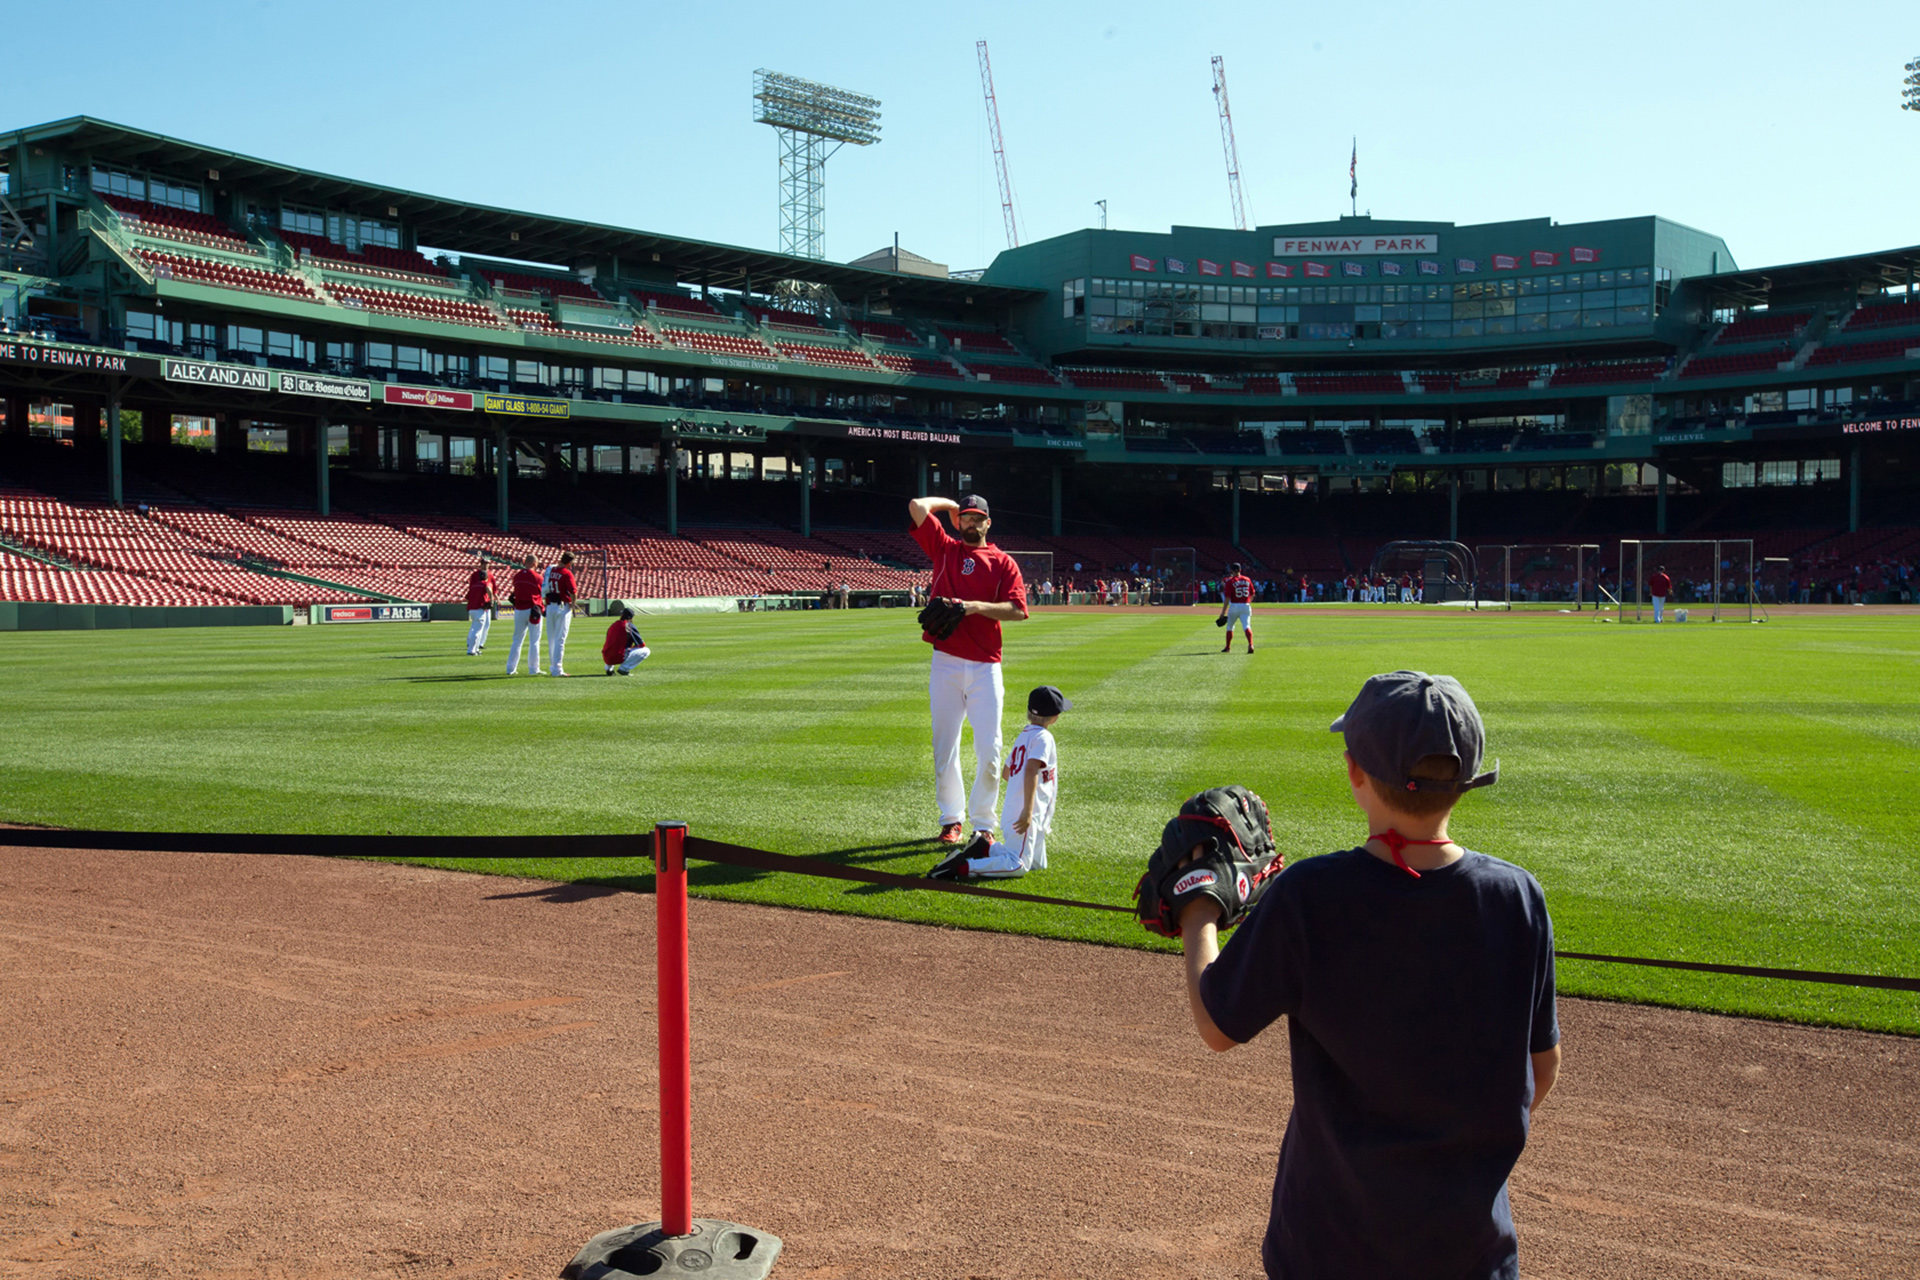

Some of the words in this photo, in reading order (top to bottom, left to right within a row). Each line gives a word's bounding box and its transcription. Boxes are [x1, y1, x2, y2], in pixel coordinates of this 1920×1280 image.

[1284, 240, 1362, 252] FENWAY
[1374, 238, 1427, 251] PARK
[21, 346, 38, 361] TO
[42, 349, 91, 367] FENWAY
[95, 355, 127, 371] PARK
[711, 356, 728, 366] STATE
[729, 358, 750, 368] STREET
[751, 360, 779, 371] PAVILION
[171, 363, 206, 381] ALEX
[209, 368, 239, 384] AND
[242, 372, 266, 387] ANI
[298, 379, 314, 391] The
[315, 381, 344, 395] Boston
[344, 384, 367, 398] Globe
[401, 391, 425, 402] Ninety
[437, 394, 454, 403] Nine
[487, 398, 505, 410] GIANT
[505, 400, 525, 412] GLASS
[526, 402, 548, 413] 1-800-54
[549, 403, 568, 415] GIANT
[1843, 421, 1882, 433] WELCOME
[1885, 420, 1897, 430] TO
[848, 427, 882, 438] AMERICA'S
[883, 429, 900, 439] MOST
[901, 430, 928, 441] BELOVED
[929, 433, 961, 444] BALLPARK
[1679, 433, 1705, 441] LEVEL
[1047, 439, 1061, 447] EMC
[1062, 440, 1082, 448] LEVEL
[962, 558, 976, 575] B
[1235, 586, 1250, 598] 55
[333, 610, 370, 618] redsox.com
[391, 608, 403, 619] At
[404, 607, 422, 619] Bat
[1174, 874, 1214, 893] Wilson
